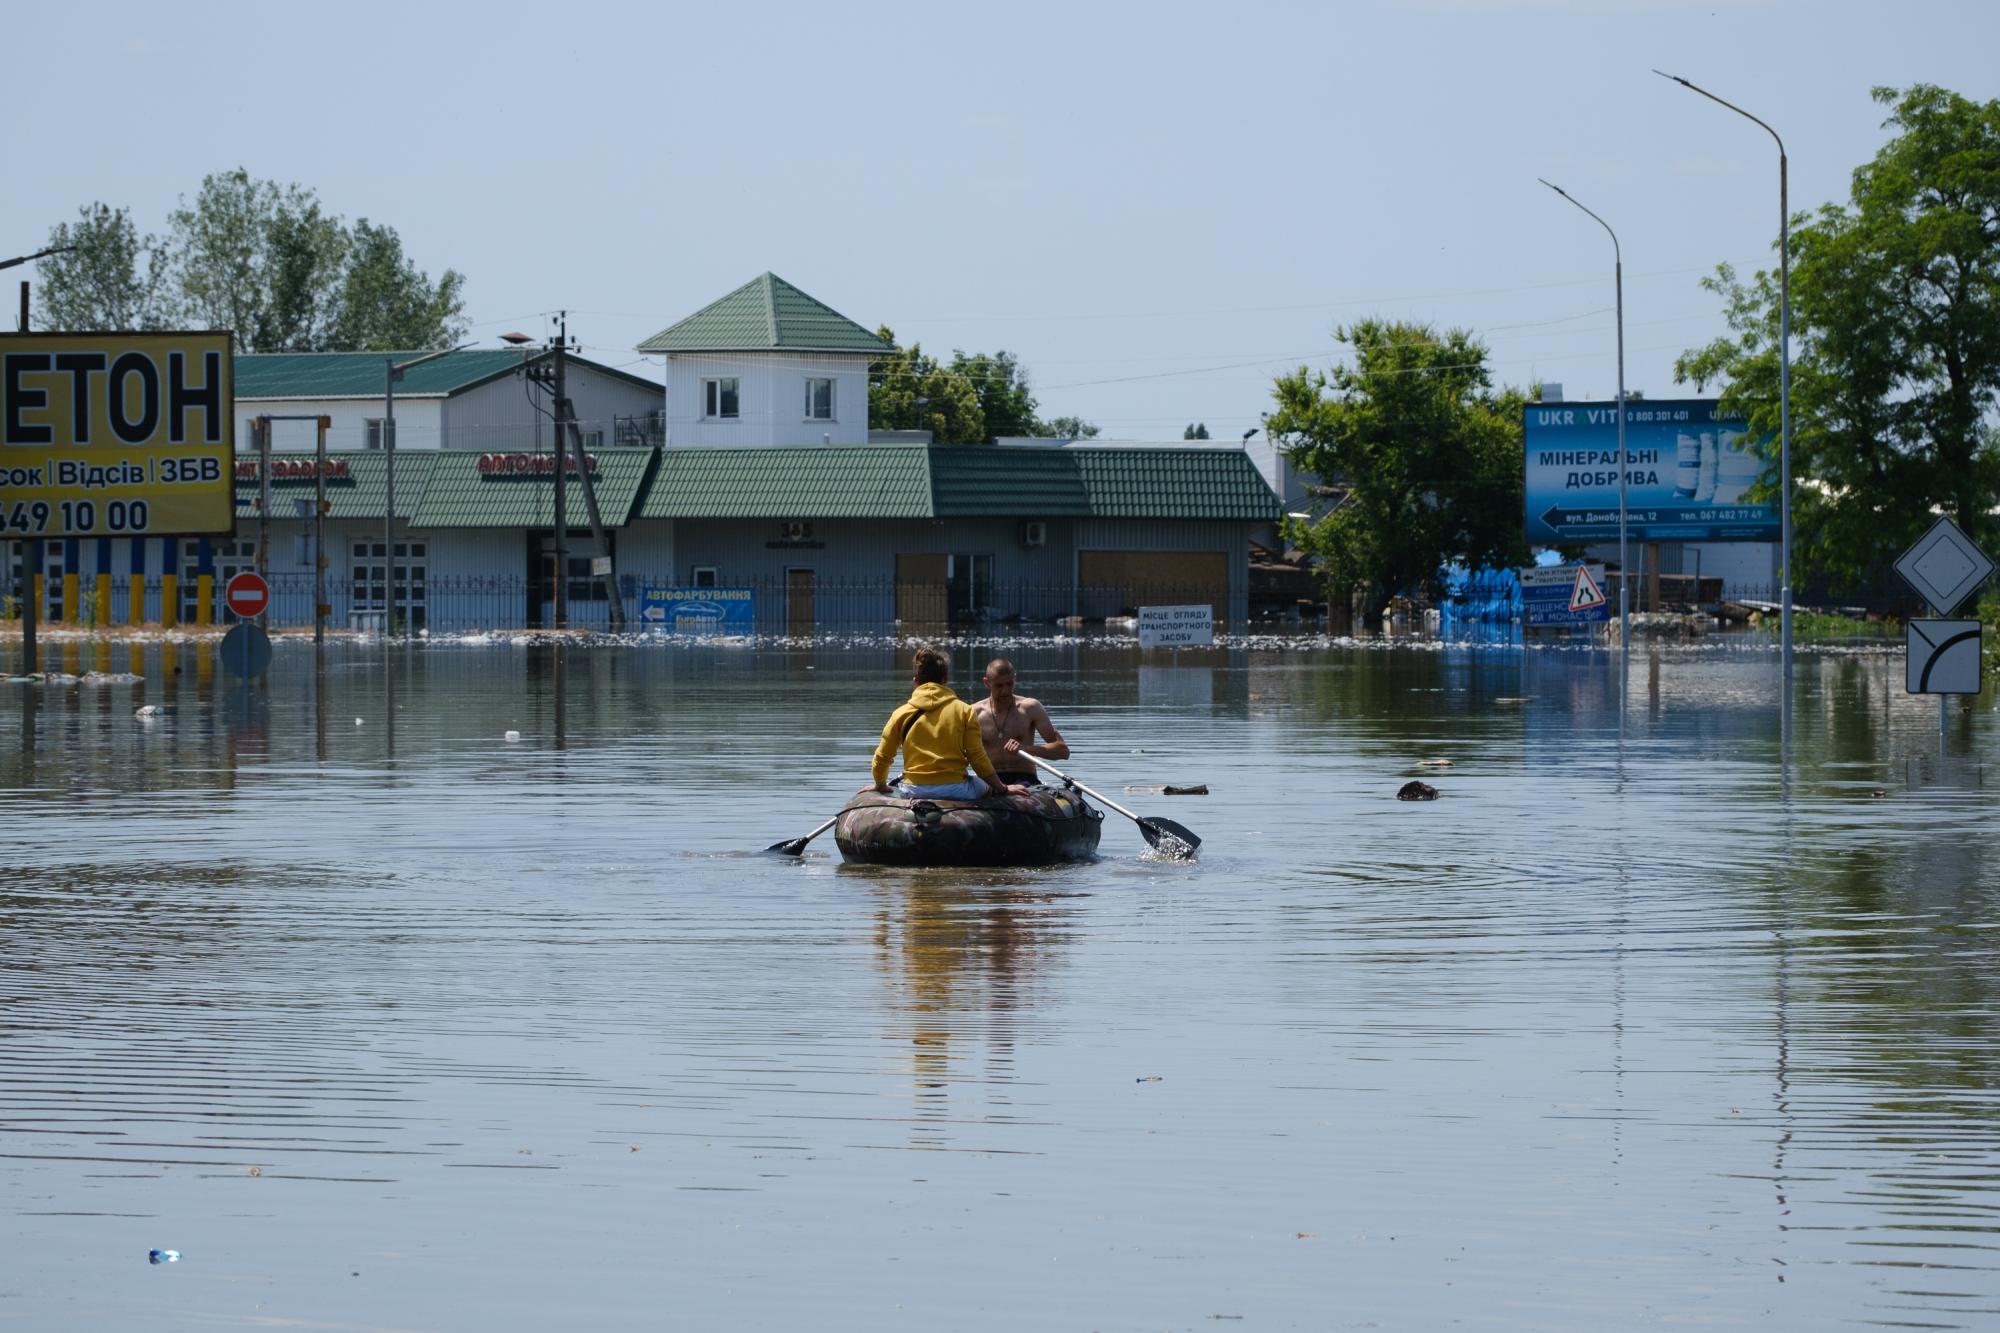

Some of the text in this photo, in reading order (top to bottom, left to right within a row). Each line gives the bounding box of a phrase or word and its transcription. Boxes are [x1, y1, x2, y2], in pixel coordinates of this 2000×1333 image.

[5, 352, 221, 444] ЕТОН
[1627, 411, 1633, 421] 0
[1636, 411, 1653, 421] 800
[1656, 410, 1671, 420] 301
[1673, 410, 1689, 420] 401
[58, 461, 145, 488] Відсів
[160, 458, 220, 483] ЗБВ
[61, 502, 94, 531] 10
[108, 501, 147, 531] 00
[1566, 515, 1584, 524] вул.
[1648, 512, 1657, 521] 12
[1680, 510, 1763, 520] тел. 067 482 77 49
[646, 590, 751, 601] АВТОФАРБУВАННЯ
[1143, 610, 1208, 620] МІСЦЕ ОГЛЯДУ
[1140, 621, 1211, 631] ТРАНСПОРТНОГО
[1160, 633, 1193, 641] ЗАСОБУ
